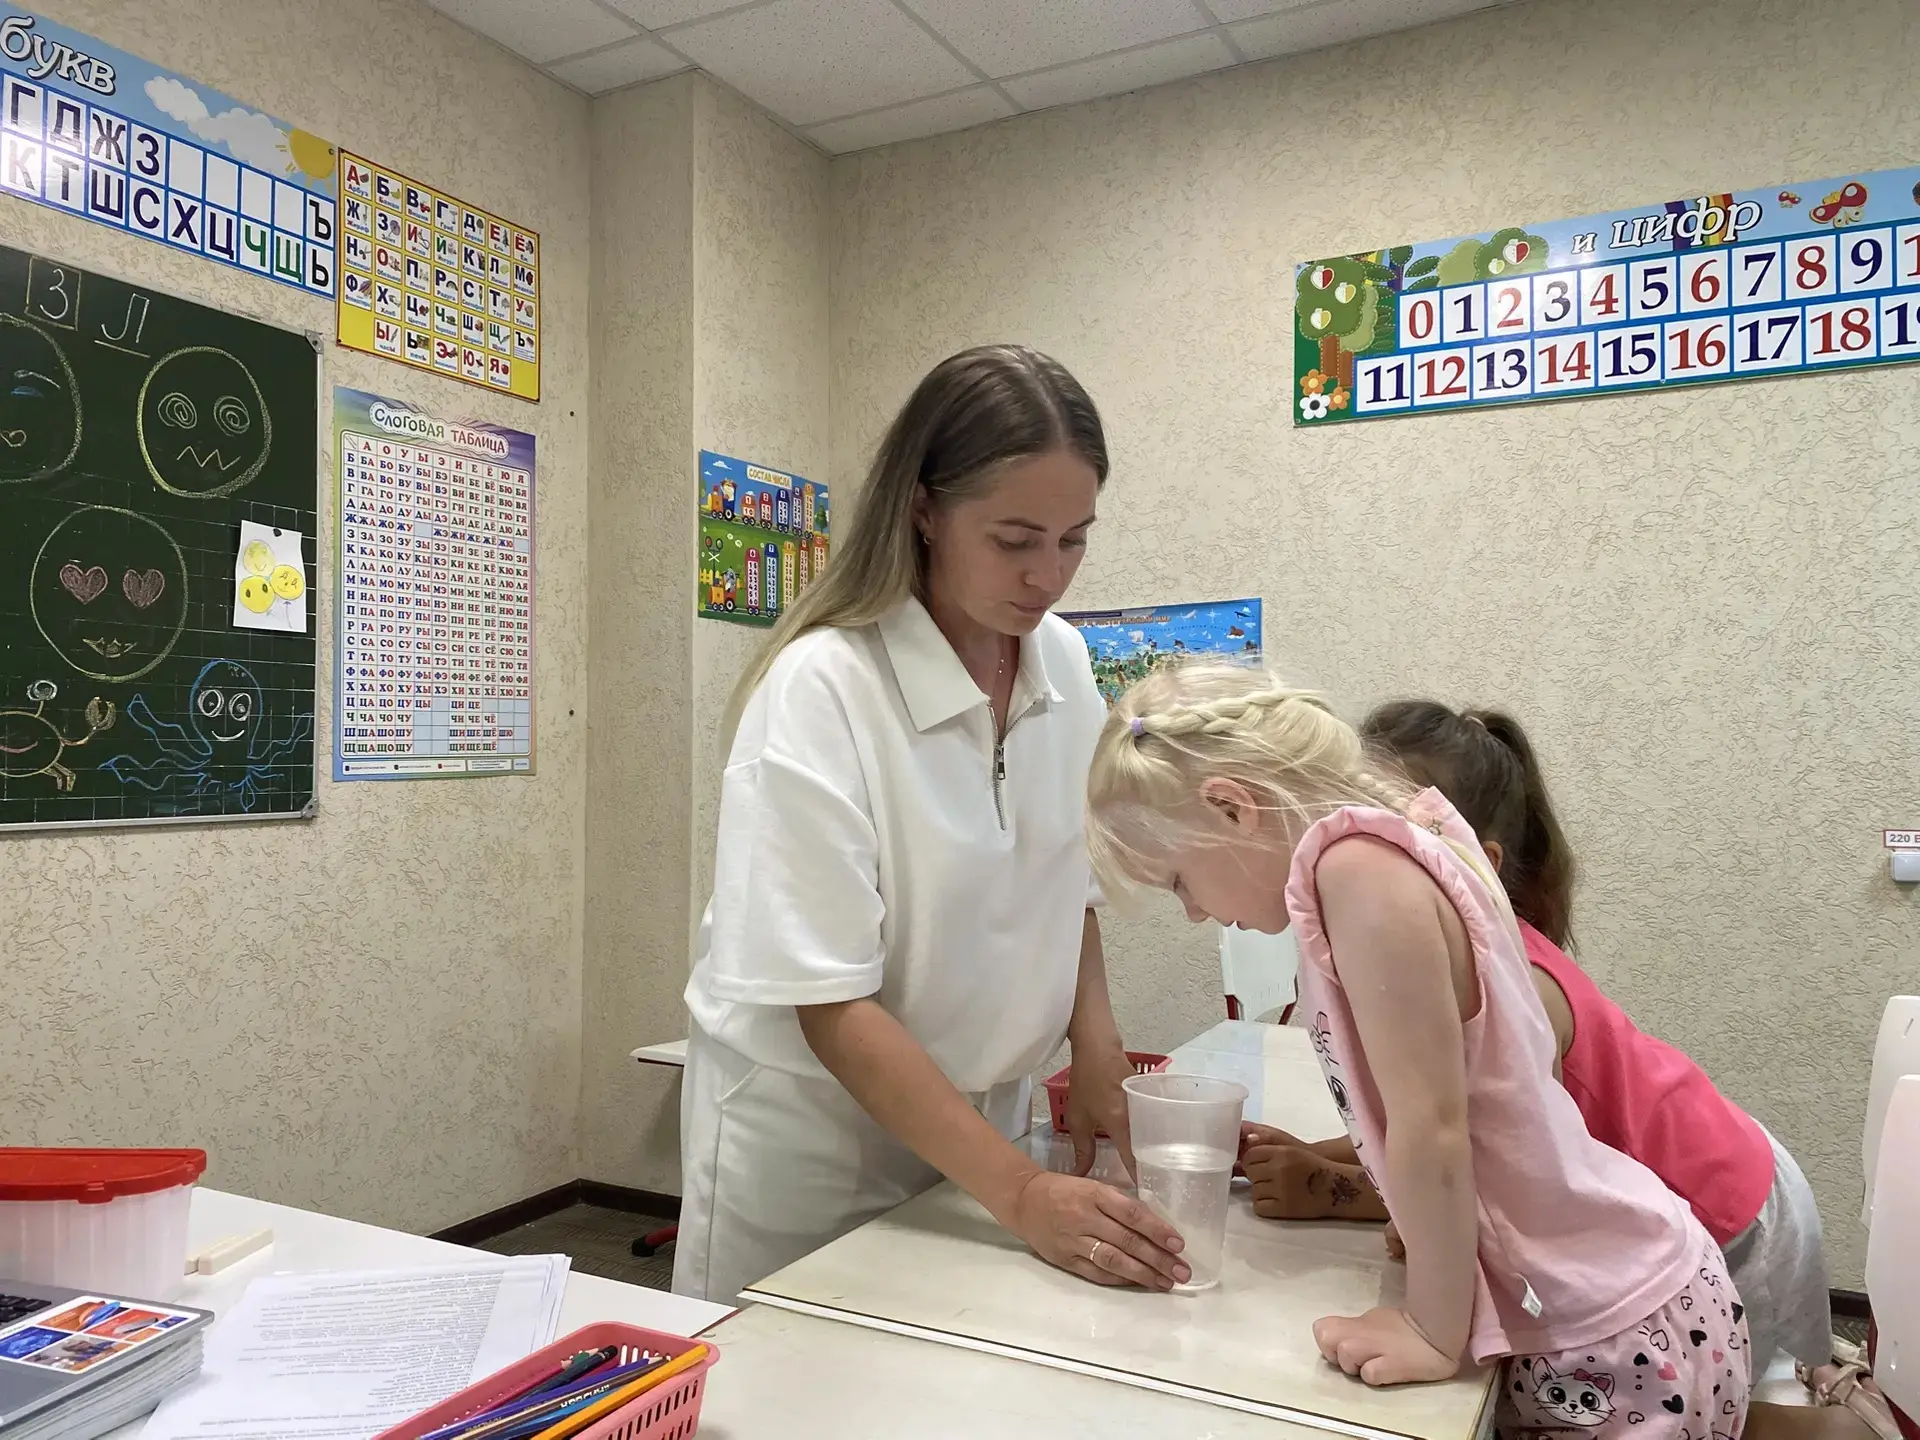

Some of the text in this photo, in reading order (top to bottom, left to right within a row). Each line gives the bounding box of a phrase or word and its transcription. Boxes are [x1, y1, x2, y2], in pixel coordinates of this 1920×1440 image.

[0, 16, 115, 95] букв
[11, 82, 332, 240] Г Д Ж З Ъ
[9, 140, 329, 286] К Т Ш С Х Ц Ч Щ Ь
[347, 165, 360, 185] А
[377, 176, 389, 196] Б
[407, 188, 418, 207] В
[437, 200, 448, 218] Г
[464, 213, 475, 232] Д
[491, 224, 500, 242] Е
[516, 234, 525, 252] Ё
[347, 198, 360, 220] Ж
[408, 224, 417, 243] И
[437, 235, 446, 255] Й
[464, 246, 474, 266] К
[490, 257, 499, 274] Л
[516, 265, 525, 282] М
[1572, 196, 1763, 254] и цифр
[347, 236, 357, 256] Н
[377, 249, 388, 266] О
[407, 259, 418, 278] П
[436, 269, 446, 286] Р
[464, 281, 474, 297] С
[490, 289, 500, 306] Т
[516, 299, 524, 312] У
[1408, 300, 1434, 339] 0
[1454, 293, 1478, 334] 1
[1496, 287, 1524, 328] 2
[1544, 280, 1571, 322] 3
[1590, 273, 1620, 315] 4
[1640, 266, 1668, 310] 5
[1690, 258, 1720, 303] 6
[1744, 252, 1776, 297] 7
[1796, 245, 1828, 290] 8
[1850, 238, 1883, 285] 9
[346, 274, 358, 292] Ф
[377, 286, 388, 305] Х
[407, 296, 418, 316] Ц
[436, 306, 445, 322] Ч
[463, 314, 473, 330] Ш
[490, 323, 500, 342] Щ
[516, 332, 525, 347] Ъ
[377, 322, 389, 341] Ы
[407, 332, 418, 349] Ь
[436, 342, 448, 358] Э
[464, 349, 474, 366] Ю
[490, 358, 499, 373] Я
[1364, 302, 1920, 404] 11 12 13 14 15 16 17 18 1
[364, 442, 524, 483] А О У Ы Э И Е Ё Ю Я
[450, 429, 506, 454] ТАБЛИЦА
[348, 454, 526, 497] Б БА БО БУ БЫ БЭ БИ БЕ БЁ БЮ БЯ
[348, 468, 526, 510] В ВА ВО ВУ ВЫ ВЭ ВИ ВЕ ВЁ ВЮ ВЯ
[348, 484, 526, 523] Г ГА ГО ГУ ГЫ ГЭ ГИ ГЕ ГЁ ГЮ ГЯ
[346, 682, 355, 691] Х
[360, 684, 374, 692] ХА
[380, 684, 393, 693] ХО
[398, 685, 411, 693] ХУ
[416, 685, 431, 694] ХЫ
[435, 686, 447, 694] ХЭ
[451, 687, 464, 695] ХИ
[468, 687, 480, 695] ХЕ
[484, 687, 496, 696] ХЁ
[516, 689, 528, 697] ХЯ
[1890, 834, 1910, 842] 220
